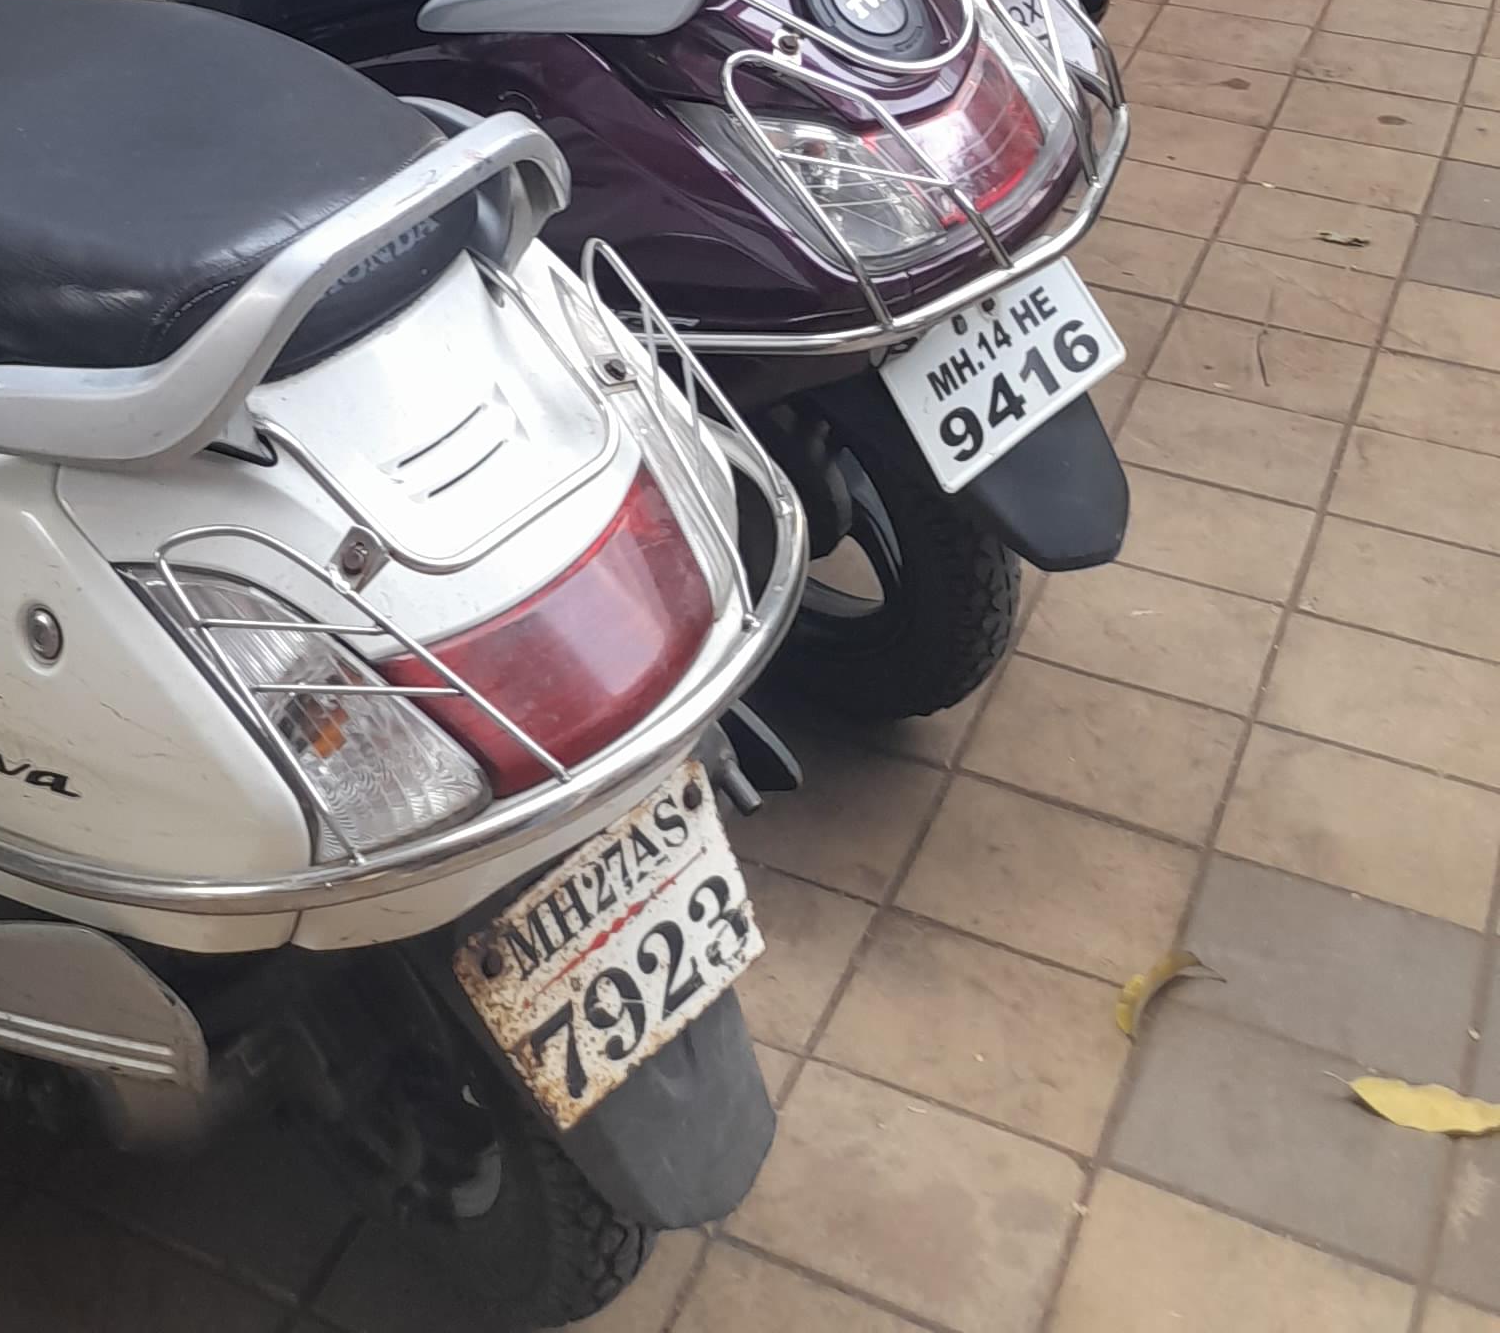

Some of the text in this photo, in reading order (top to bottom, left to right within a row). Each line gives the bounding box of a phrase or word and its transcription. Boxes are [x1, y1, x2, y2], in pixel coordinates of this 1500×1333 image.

[938, 319, 1100, 463] 9416
[1009, 285, 1058, 336] HE
[506, 794, 689, 981] MH27AS
[528, 874, 749, 1099] 7923
